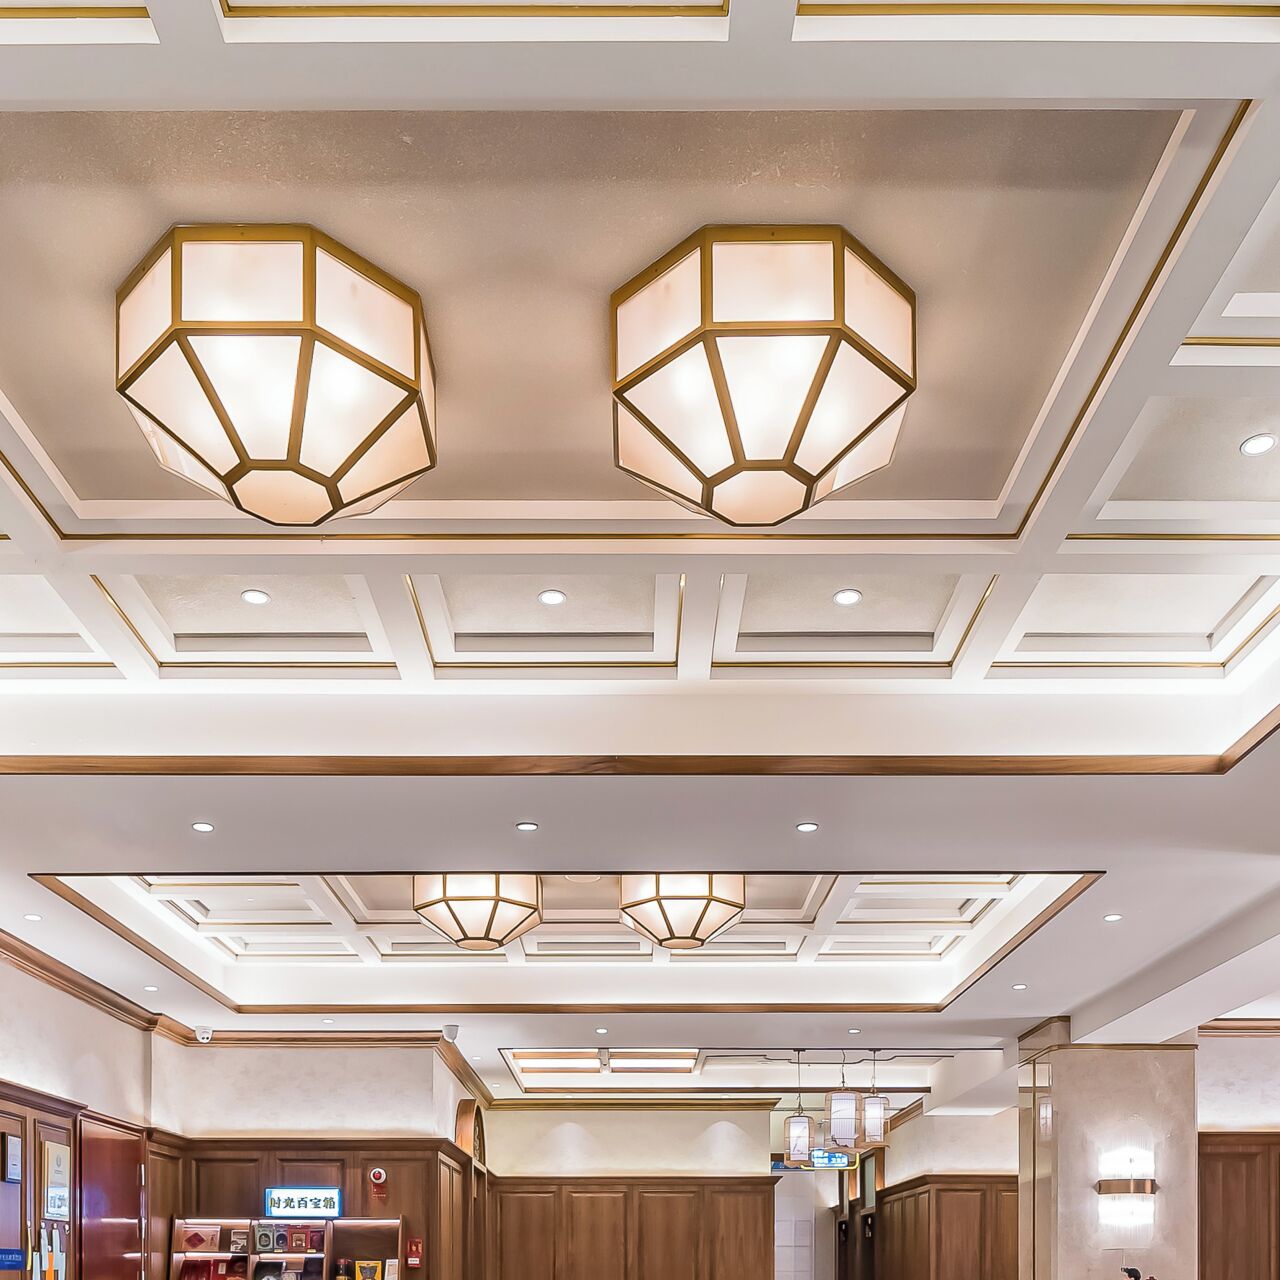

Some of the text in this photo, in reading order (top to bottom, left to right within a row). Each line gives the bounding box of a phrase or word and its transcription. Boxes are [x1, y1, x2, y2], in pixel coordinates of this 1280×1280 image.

[269, 1196, 336, 1209] 时光百宝箱
